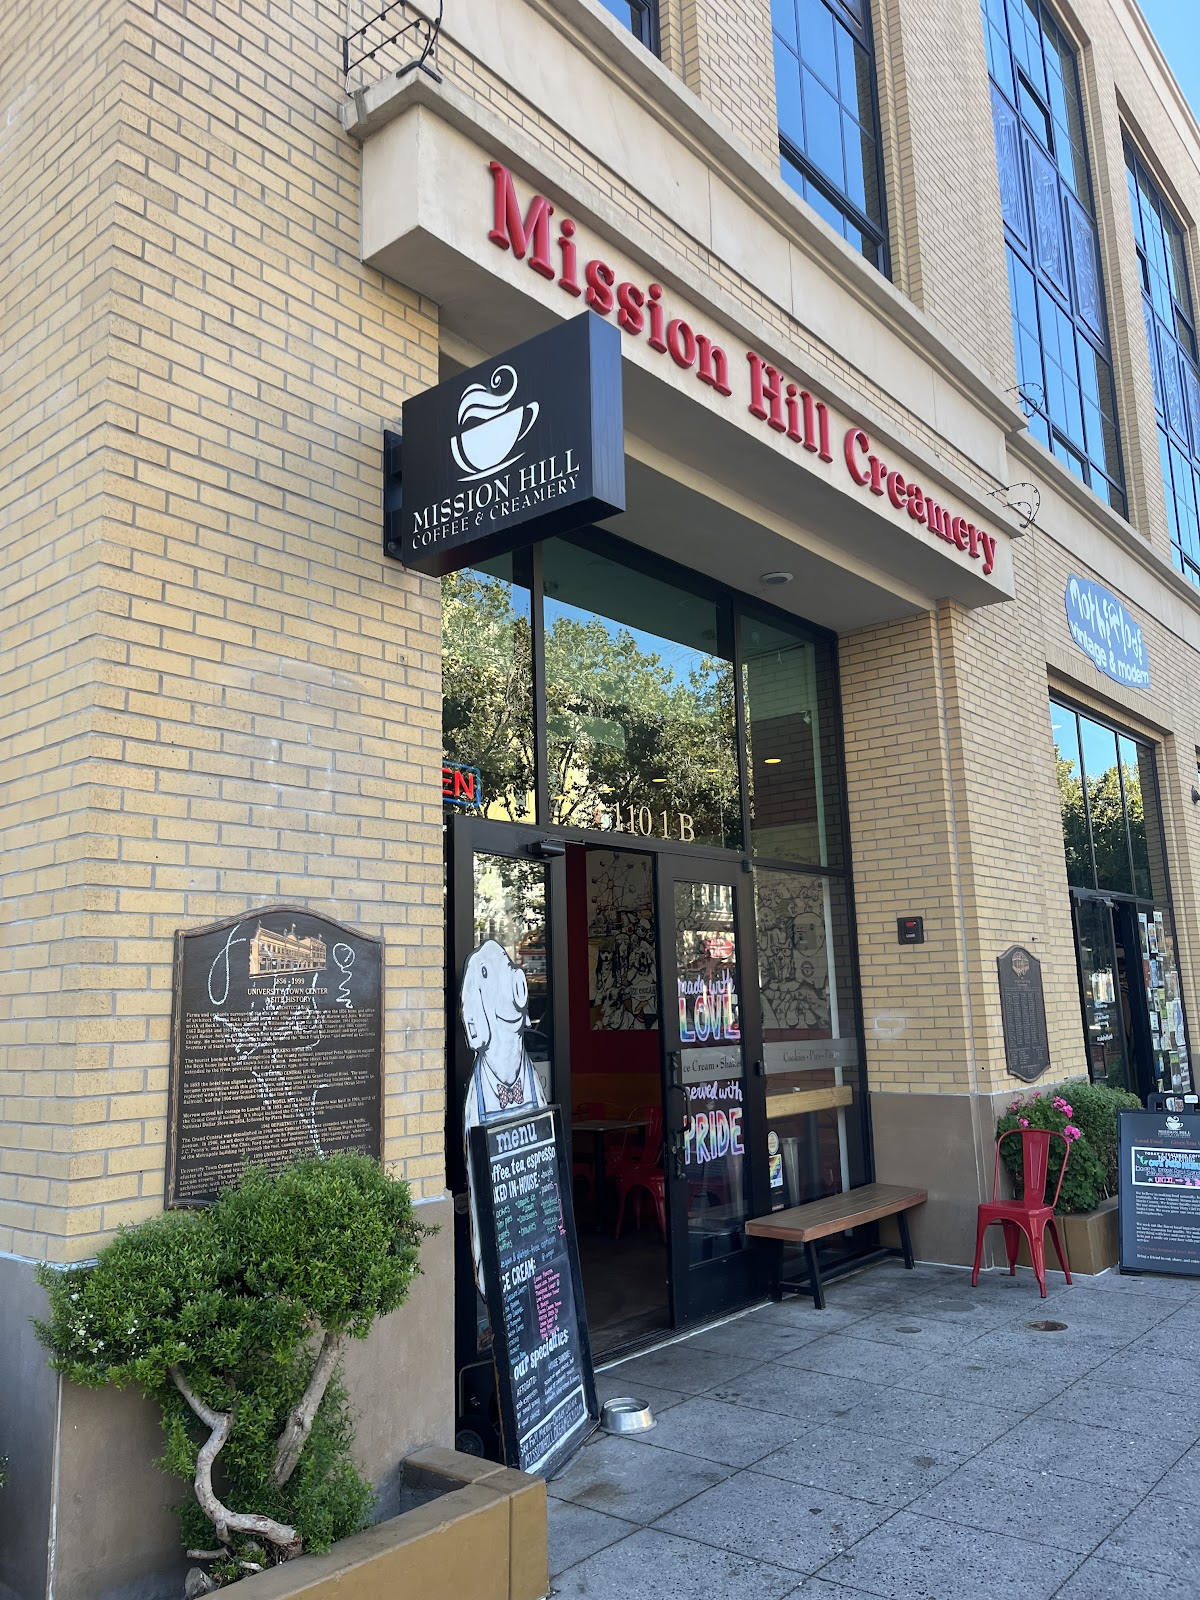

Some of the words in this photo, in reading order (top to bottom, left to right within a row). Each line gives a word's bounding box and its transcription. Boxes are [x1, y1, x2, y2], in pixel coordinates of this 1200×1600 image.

[488, 161, 733, 396] Mission
[746, 351, 834, 463] Hill
[844, 428, 997, 575] Creamery
[412, 473, 511, 534] MISSION
[519, 449, 581, 498] HILL
[411, 515, 470, 550] COFFEE
[474, 512, 485, 523] &
[489, 476, 579, 522] CREAMERY
[1070, 620, 1107, 667] vintage
[1109, 650, 1117, 673] &
[1117, 660, 1149, 684] modern
[247, 988, 286, 996] UNIVERSITY
[305, 987, 328, 995] CENTER
[709, 967, 735, 994] with
[286, 995, 311, 1003] HISTORY
[678, 993, 741, 1043] LOVE
[691, 1060, 715, 1071] Cream
[718, 1081, 743, 1102] with
[495, 1122, 538, 1154] menu
[683, 1107, 745, 1165] PRIDE
[526, 1146, 556, 1170] espresso
[511, 1257, 537, 1286] CREAM:
[513, 1355, 530, 1381] our
